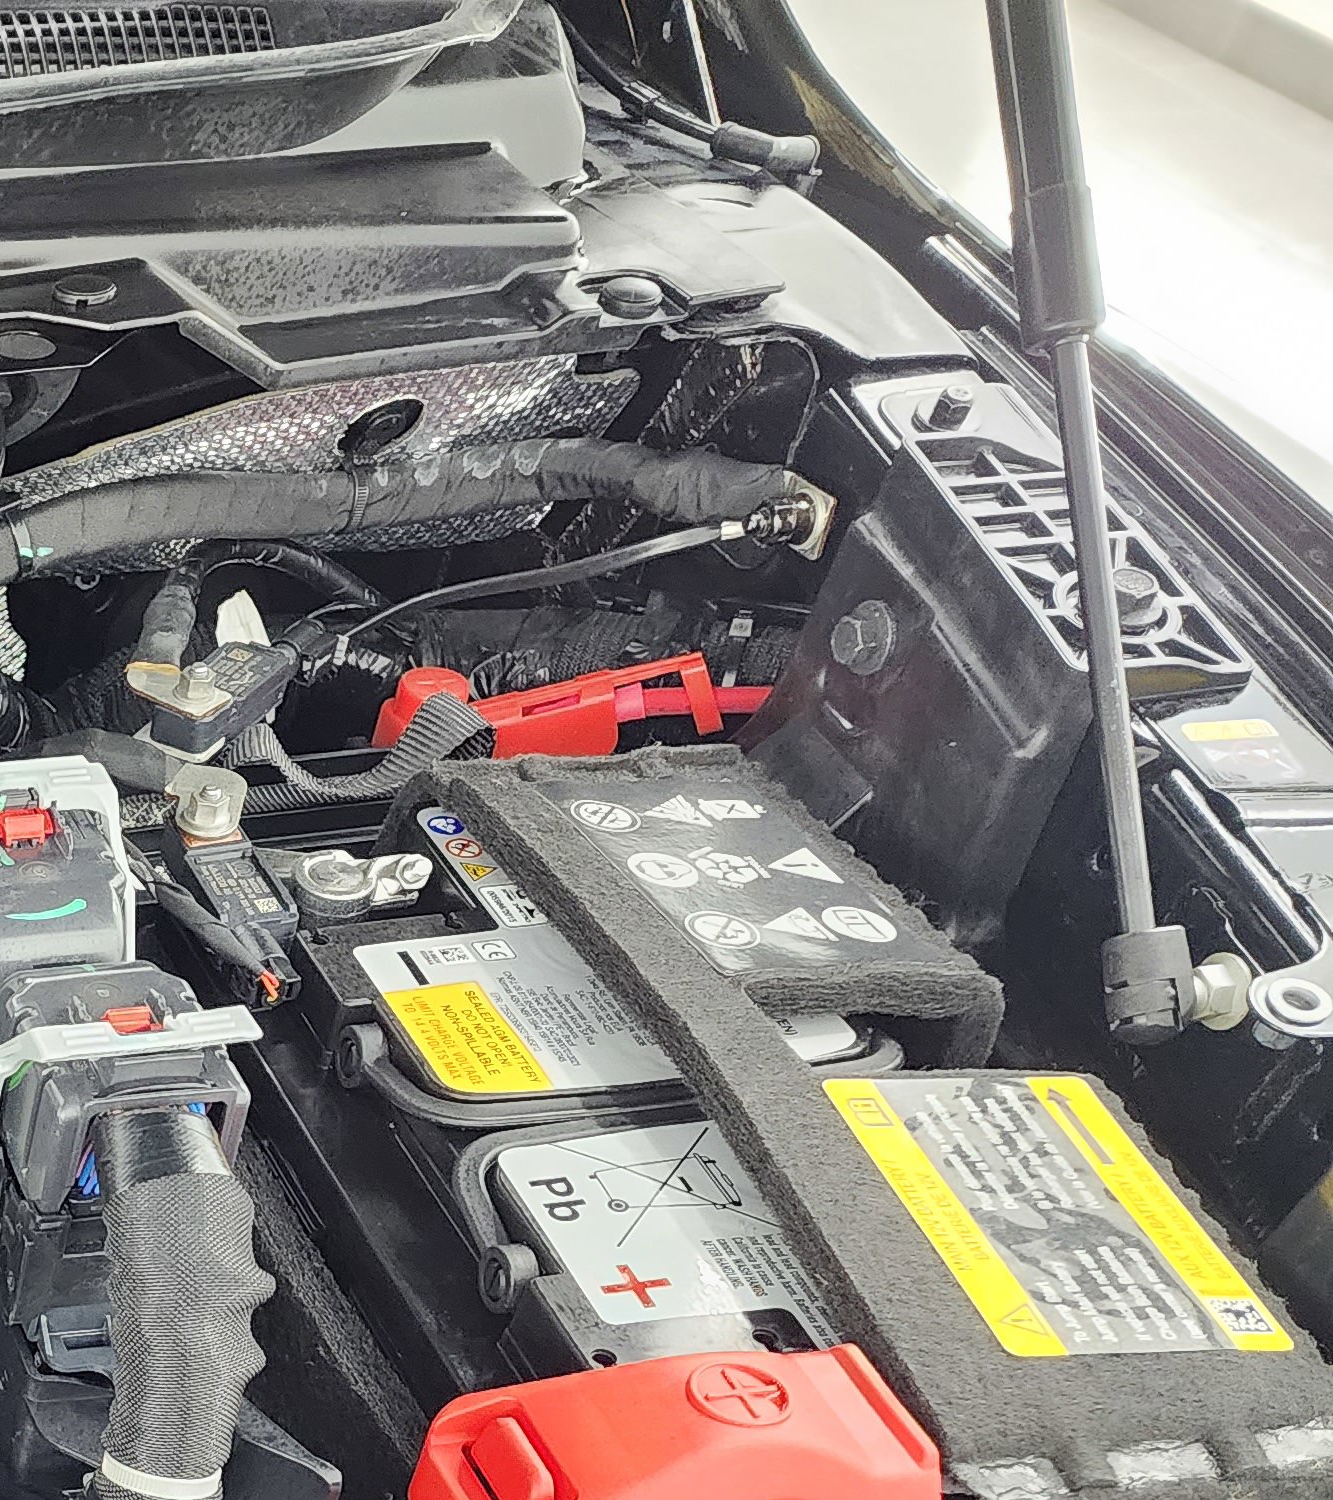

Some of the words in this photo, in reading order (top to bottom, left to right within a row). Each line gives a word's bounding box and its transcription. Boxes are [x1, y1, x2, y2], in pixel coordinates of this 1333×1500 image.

[403, 1003, 416, 1012] TO
[425, 1036, 449, 1059] VOLTS
[443, 1062, 461, 1079] MAX
[413, 996, 435, 1015] LIMIT
[429, 1019, 455, 1048] CHARGE
[453, 1052, 484, 1084] VOLTAGE
[442, 1005, 499, 1074] NON-SPILLABLE
[461, 1009, 477, 1020] DO
[472, 1023, 491, 1038] NOT
[465, 991, 494, 1022] SEALED
[490, 1025, 511, 1042] AGM
[505, 1044, 540, 1081] BATTERY
[528, 1176, 581, 1222] Pb
[702, 1241, 722, 1256] AFTER
[732, 1237, 757, 1262] California
[733, 1258, 752, 1275] WASH
